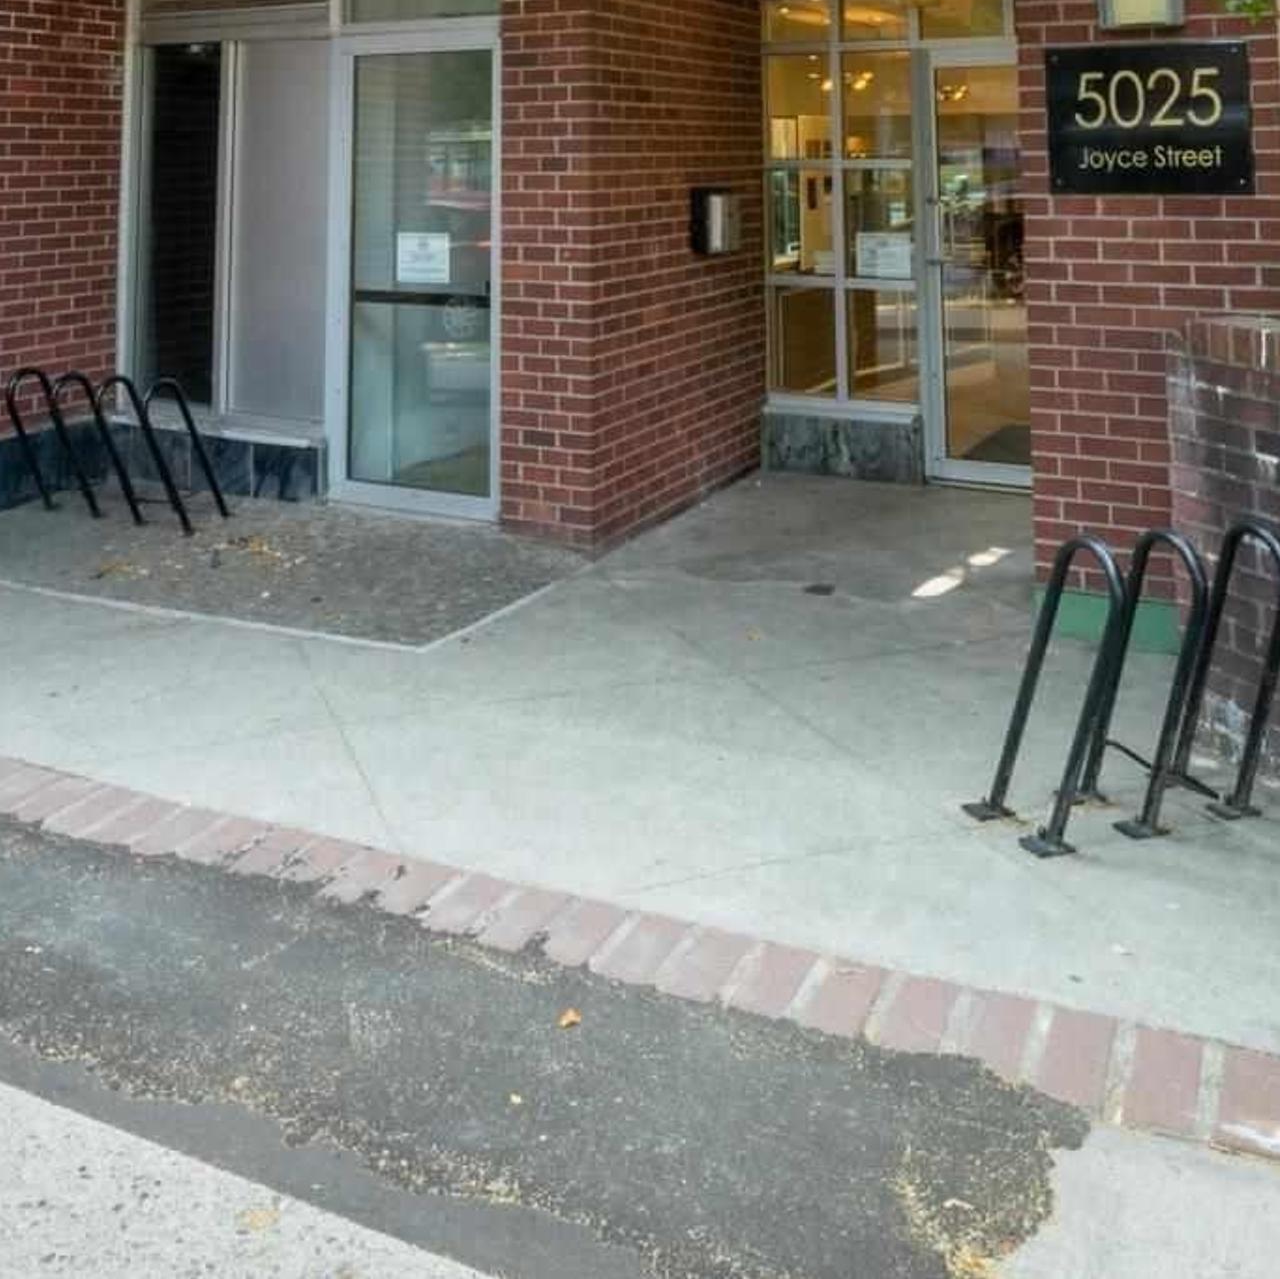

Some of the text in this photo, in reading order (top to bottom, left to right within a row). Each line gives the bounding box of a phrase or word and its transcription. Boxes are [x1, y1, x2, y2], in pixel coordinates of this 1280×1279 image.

[1075, 67, 1222, 128] 5025
[1078, 145, 1223, 173] Joyce Street
